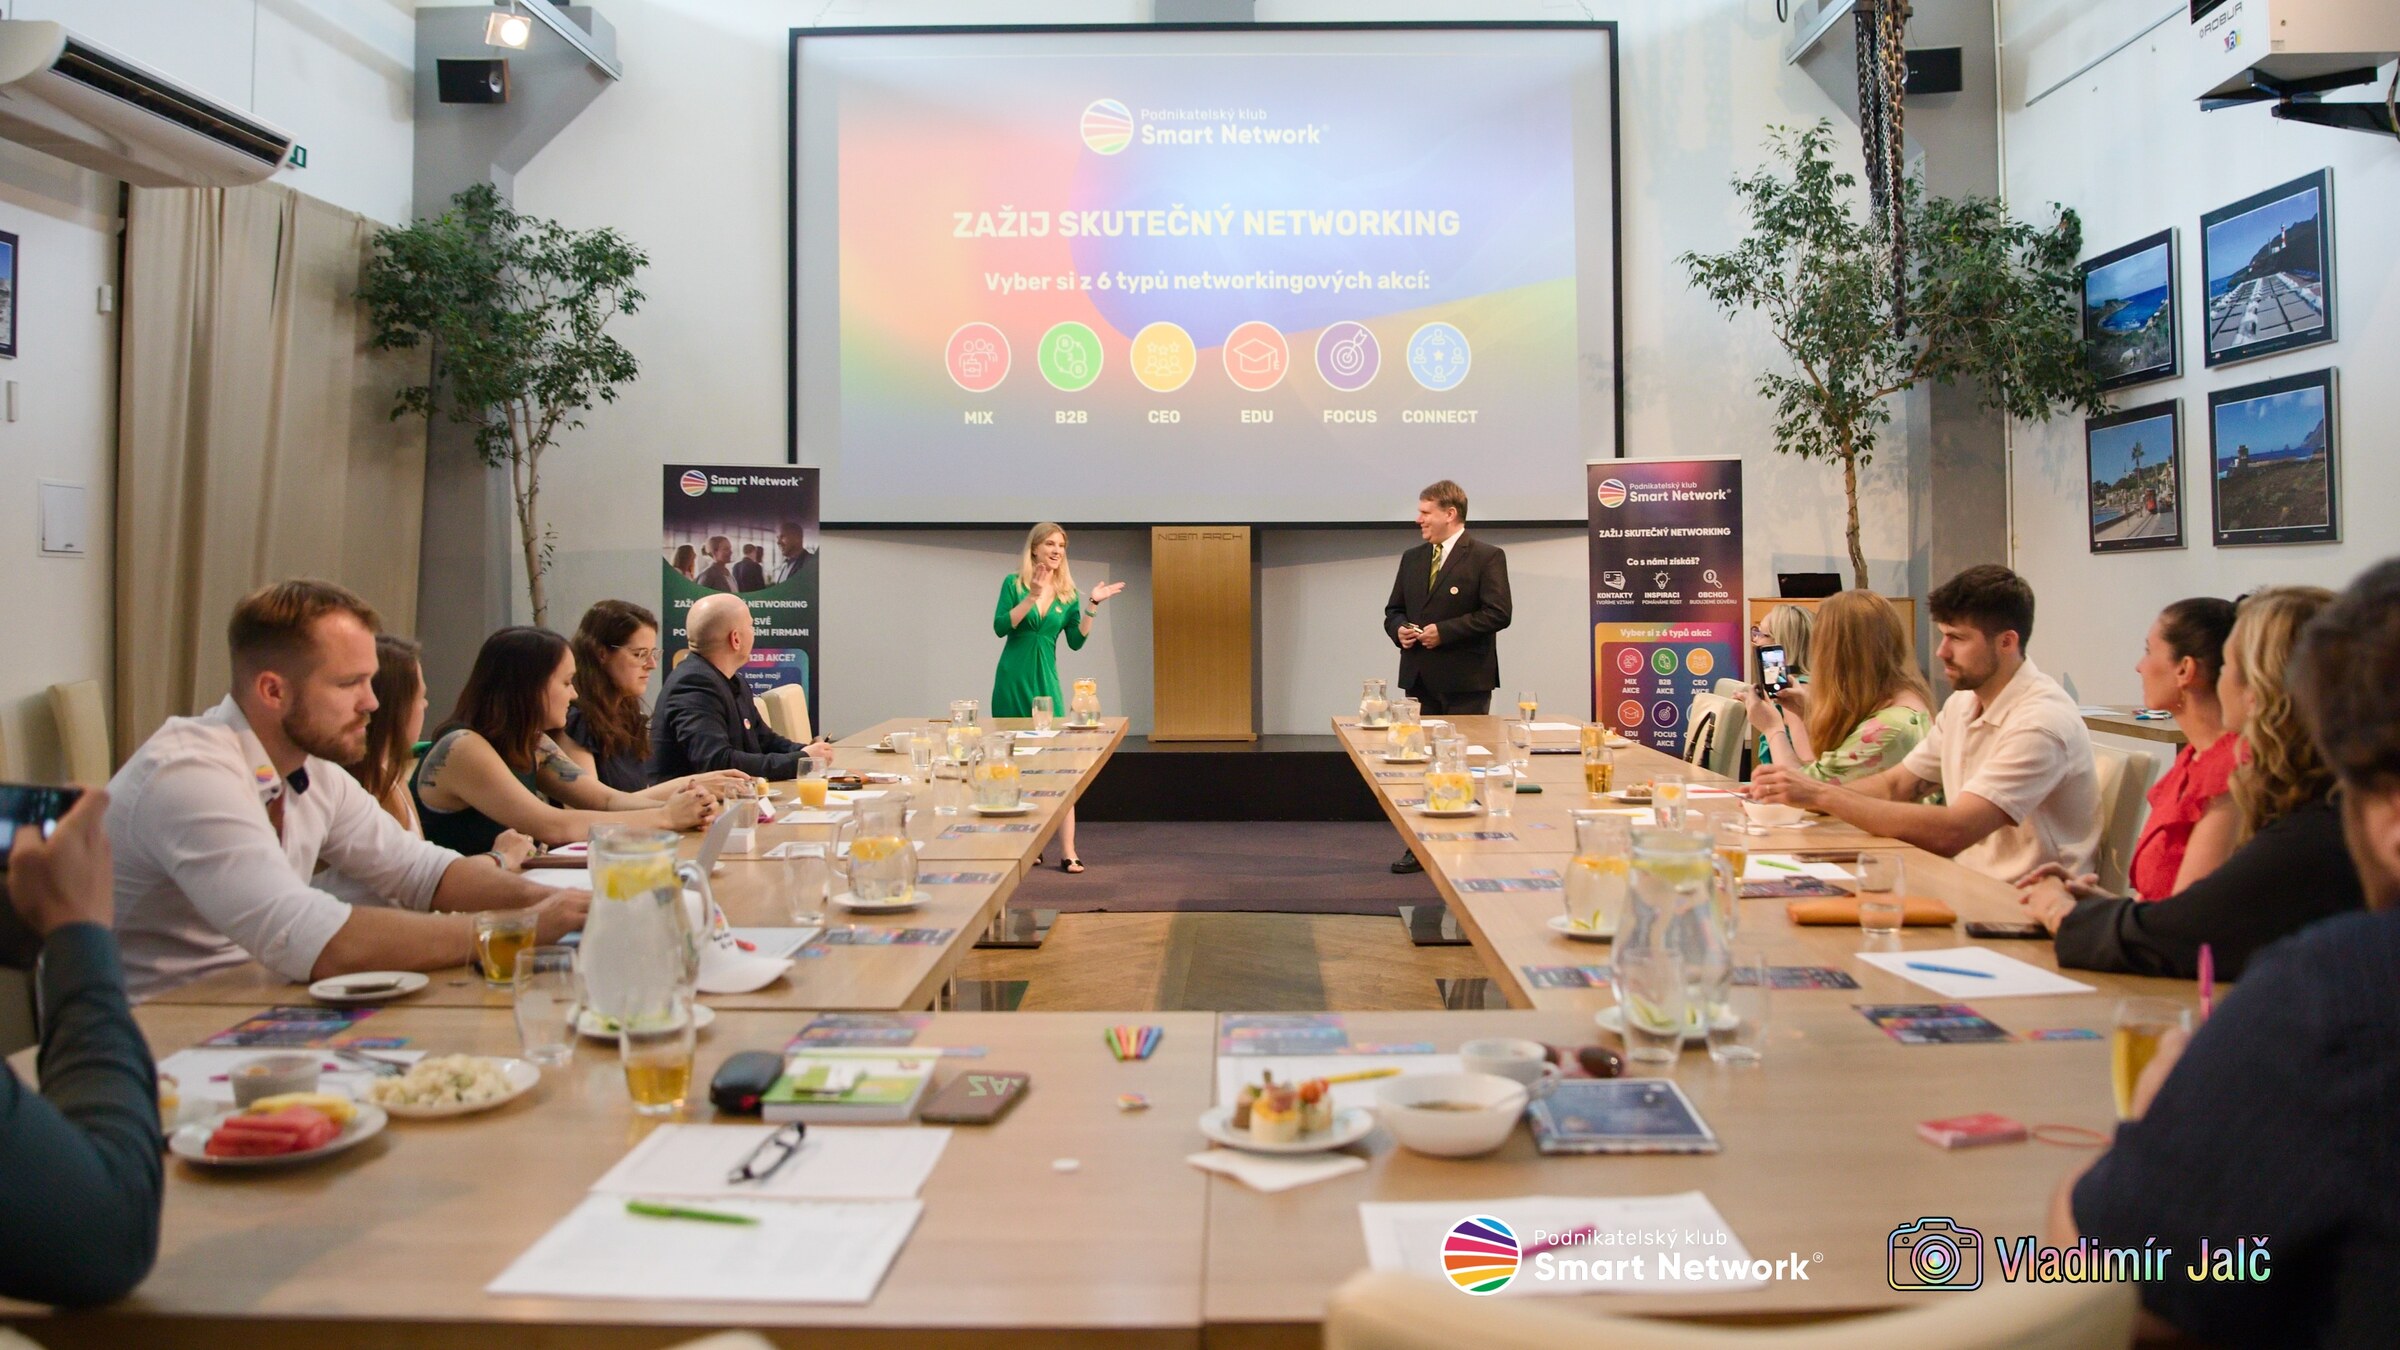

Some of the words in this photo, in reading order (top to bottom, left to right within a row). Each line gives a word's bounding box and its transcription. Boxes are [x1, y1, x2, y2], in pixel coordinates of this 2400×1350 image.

[1141, 109, 1234, 122] Podnikatelský
[1239, 109, 1267, 121] klub
[1141, 124, 1214, 145] Smart
[953, 204, 1050, 238] ZAŽIJ
[1058, 203, 1235, 237] SKUTEČNÝ
[1243, 210, 1460, 236] NETWORKING
[984, 272, 1051, 295] Vyber
[1056, 271, 1075, 290] si
[1080, 275, 1092, 290] z
[1097, 272, 1111, 290] 6
[1116, 270, 1168, 294] typů
[1174, 270, 1372, 294] networkingových
[1377, 270, 1430, 290] akcí:
[965, 411, 994, 425] MIX
[1055, 411, 1088, 424] B2B
[1148, 410, 1181, 424] CEO
[1241, 410, 1274, 423] EDU
[1323, 410, 1377, 424] FOCUS
[1402, 410, 1478, 424] CONNECT
[710, 475, 747, 486] Smart
[1629, 482, 1680, 491] Podnikatelský
[1681, 481, 1698, 489] klub
[1629, 491, 1669, 502] Smart
[1157, 532, 1198, 541] NOEM
[1599, 528, 1623, 538] ZAŽIJ
[1624, 527, 1669, 538] SKUTEČNÝ
[1671, 527, 1731, 537] NETWORKING
[1626, 558, 1639, 566] Co
[1647, 557, 1668, 566] námi
[1644, 591, 1680, 599] INSPIRACI
[1697, 591, 1729, 599] OBCHOD
[748, 600, 808, 608] NETWORKING
[754, 615, 772, 625] SVÉ
[771, 628, 809, 637] FIRMAMI
[1620, 629, 1646, 638] Vyber
[1662, 629, 1668, 637] 6
[1669, 628, 1690, 638] typů
[766, 653, 796, 661] AKCE?
